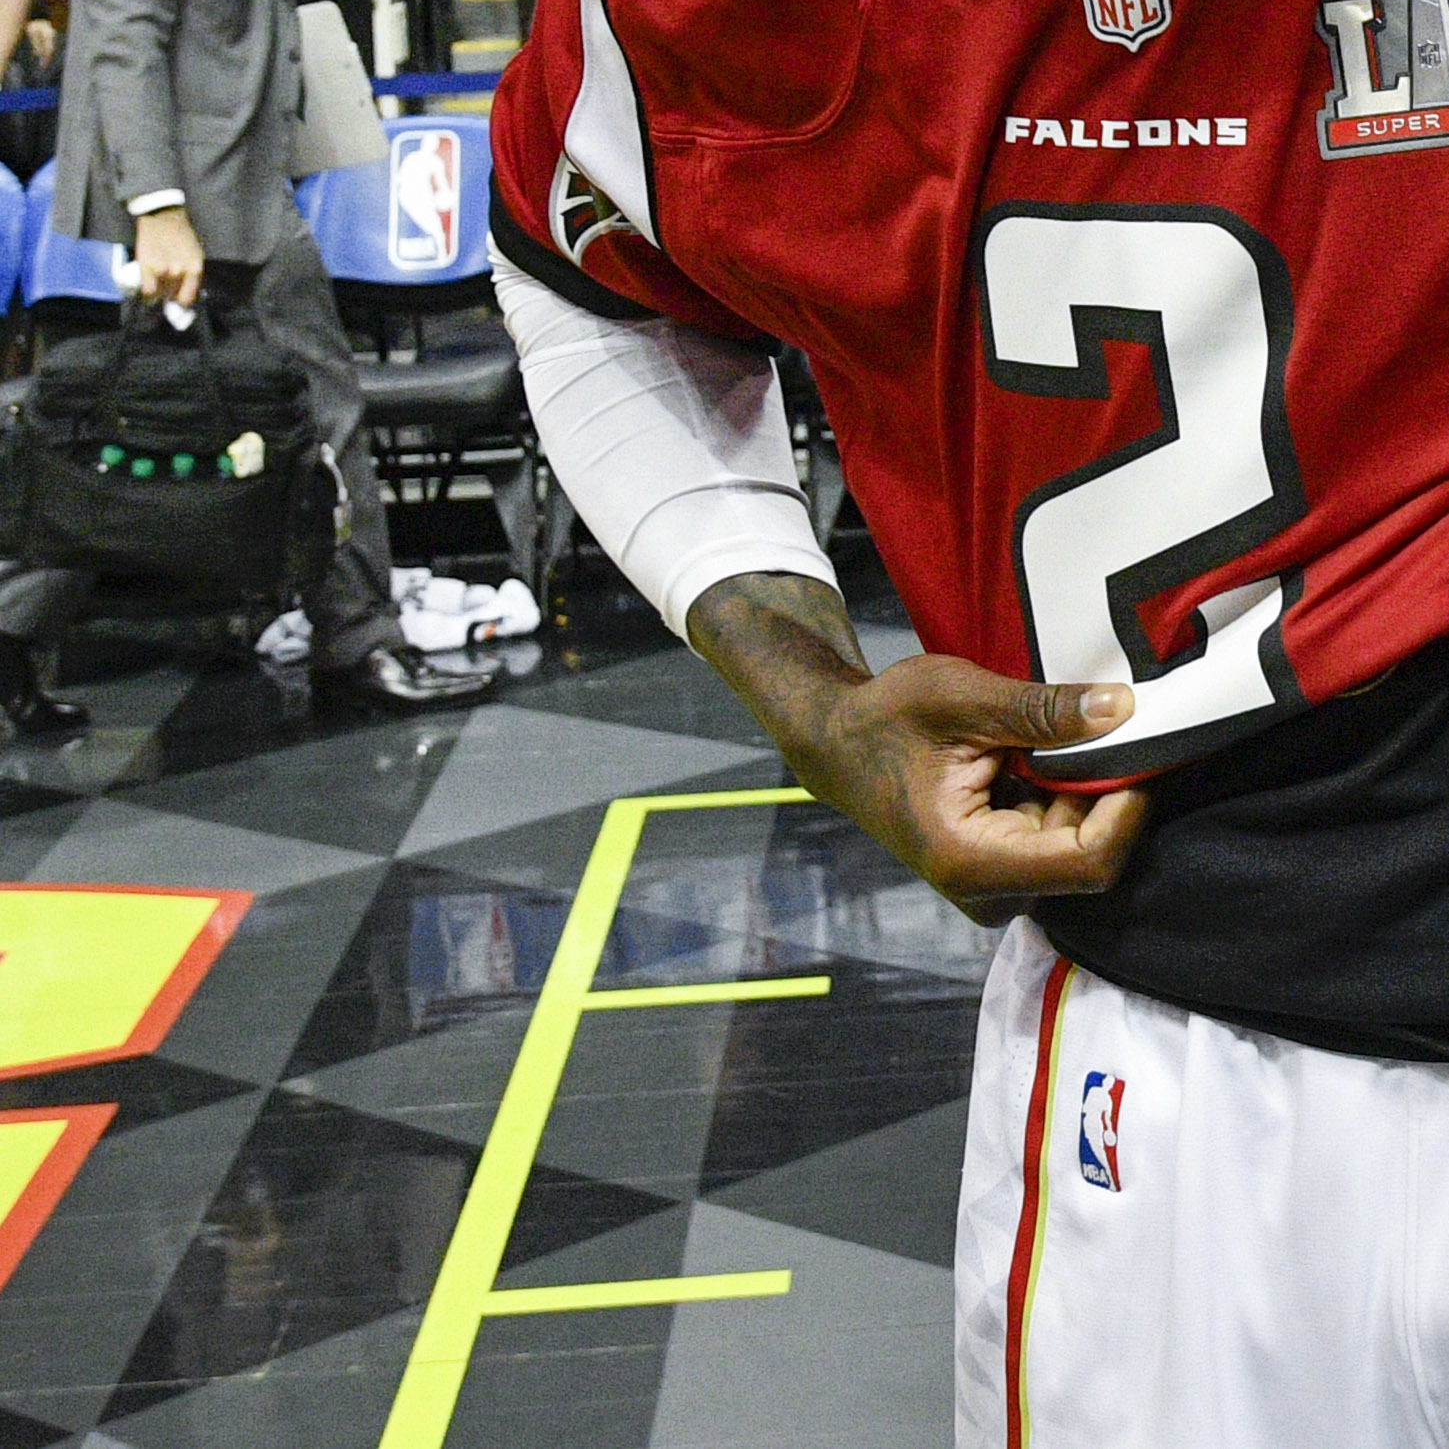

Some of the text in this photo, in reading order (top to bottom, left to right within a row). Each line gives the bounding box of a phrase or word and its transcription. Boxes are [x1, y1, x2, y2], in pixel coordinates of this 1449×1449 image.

[1005, 115, 1248, 148] FALCONS
[1356, 113, 1441, 138] SUPER
[978, 207, 1306, 775] 2
